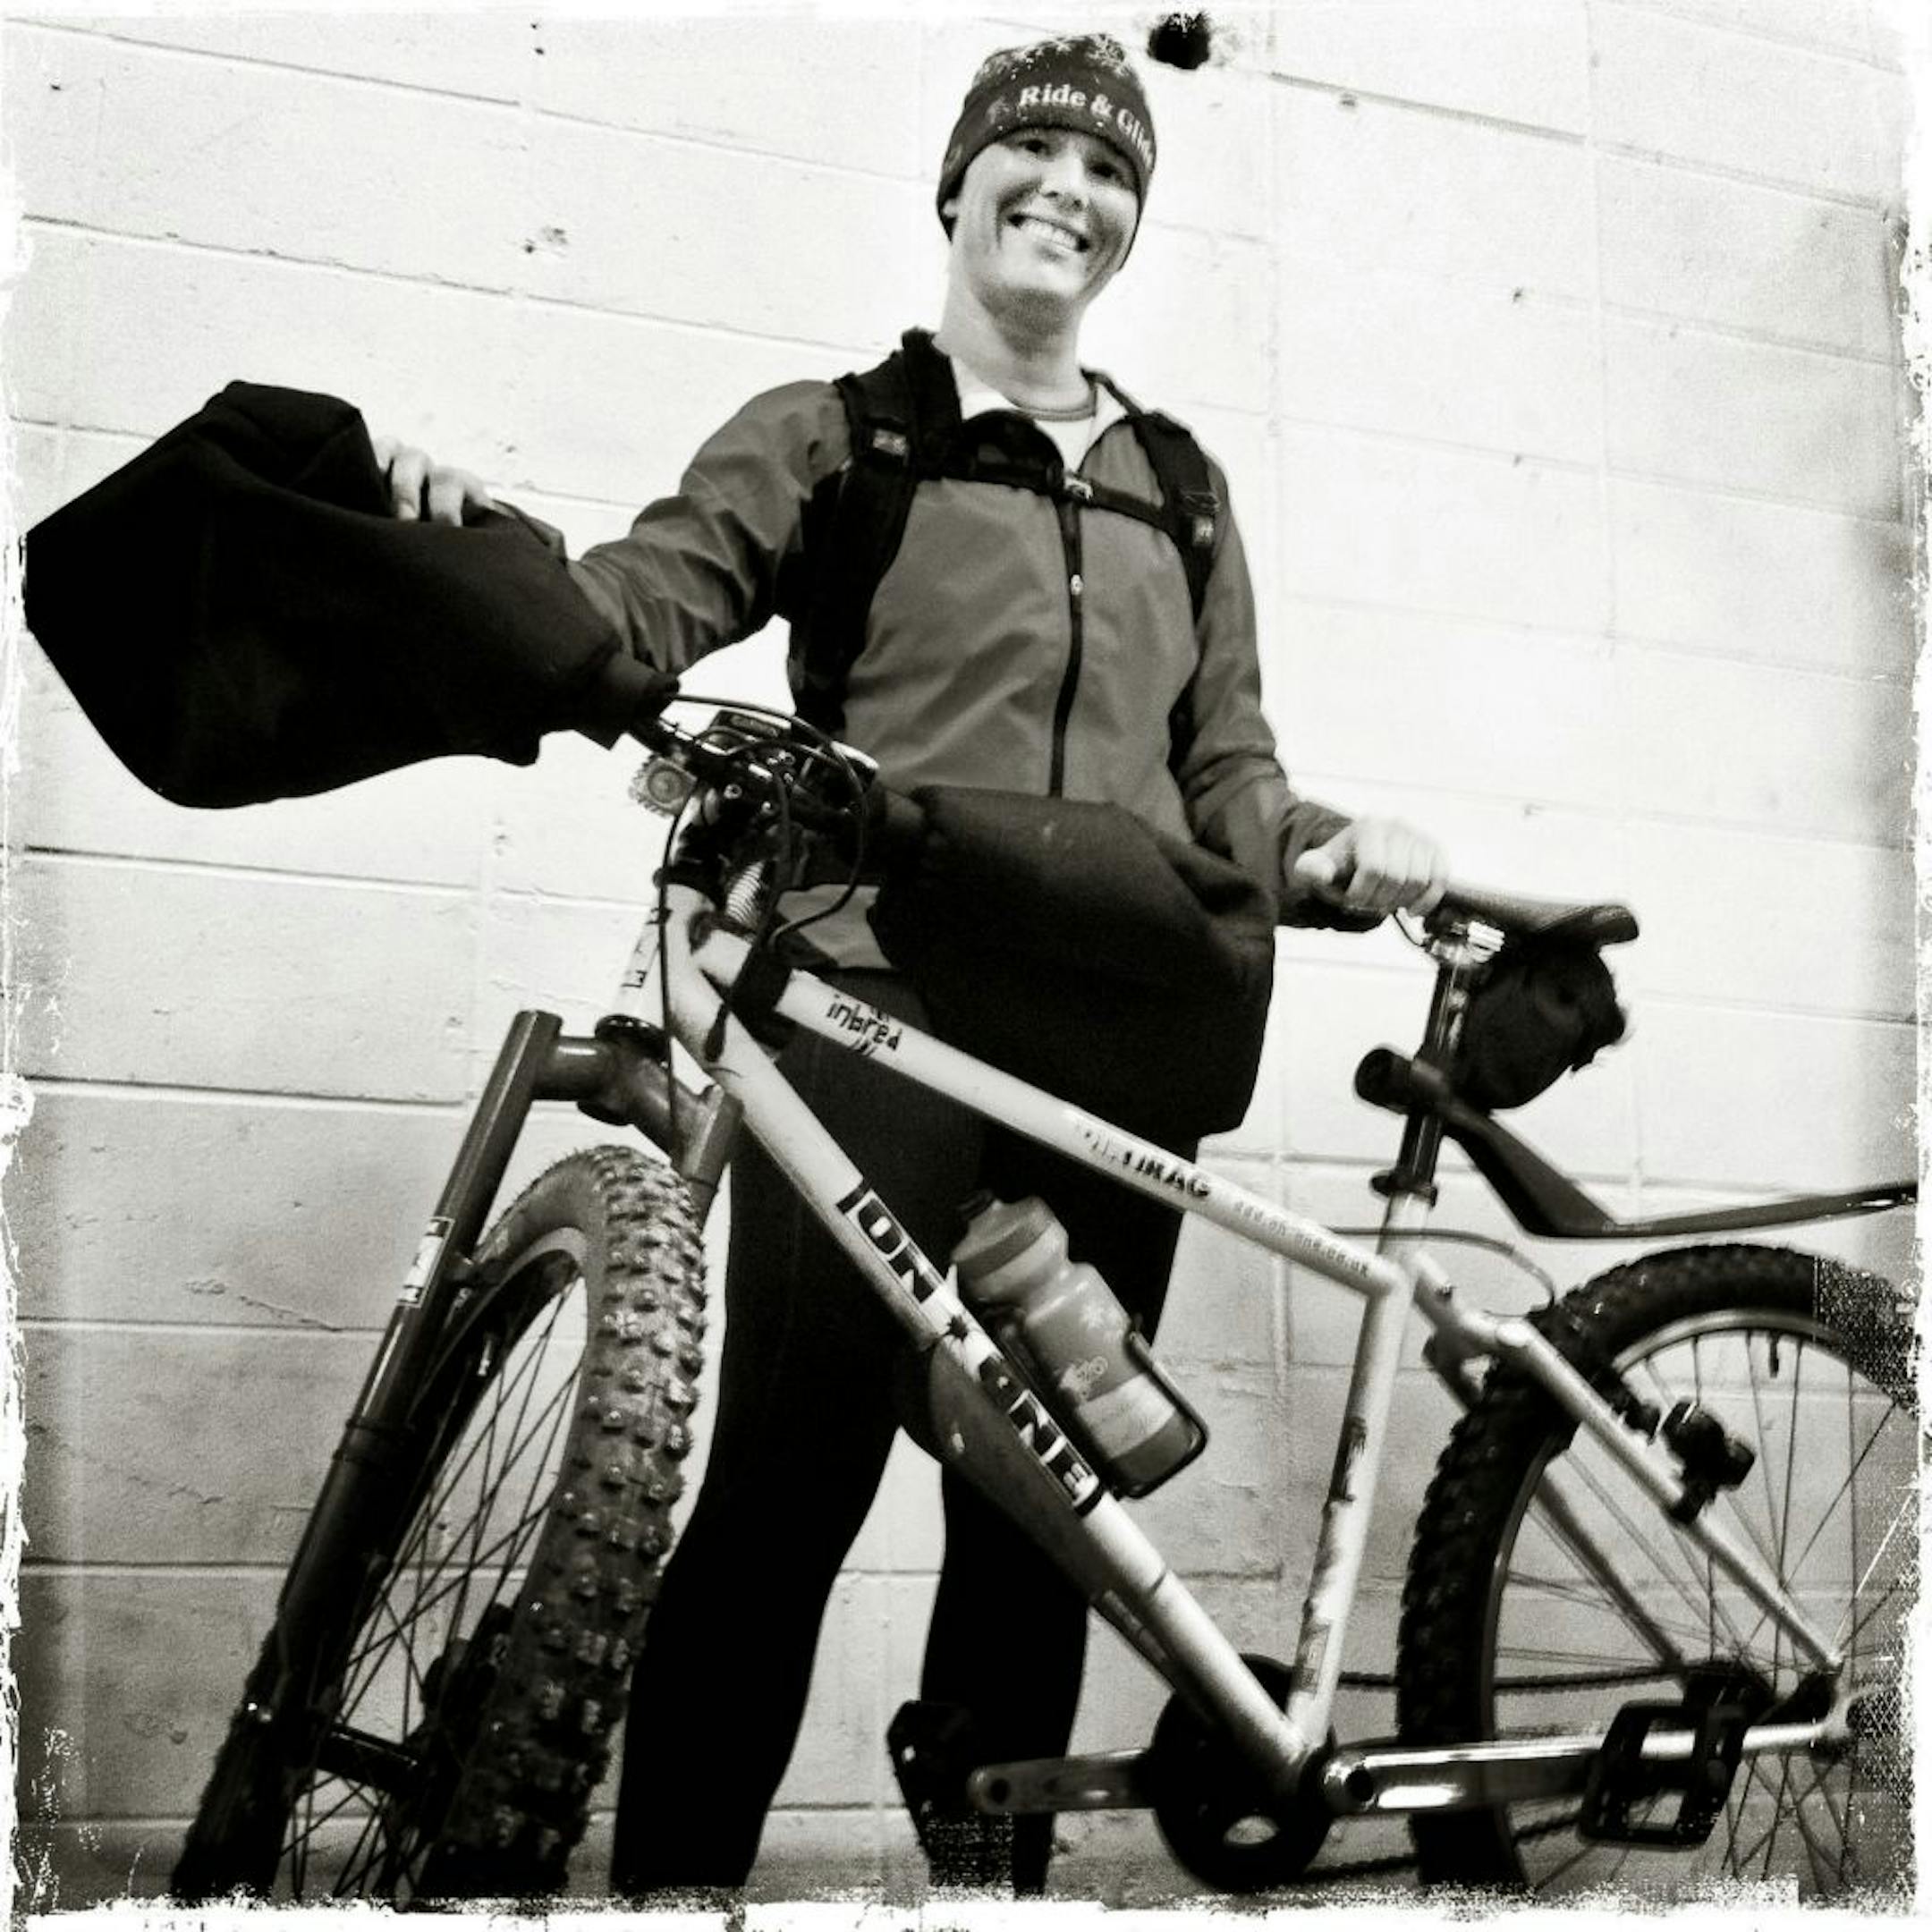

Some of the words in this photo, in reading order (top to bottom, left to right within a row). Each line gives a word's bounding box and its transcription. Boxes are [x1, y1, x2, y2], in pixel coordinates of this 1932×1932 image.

[1018, 83, 1087, 107] Ride
[1090, 93, 1114, 121] &
[826, 994, 902, 1051] inbred
[856, 1196, 936, 1304] ON
